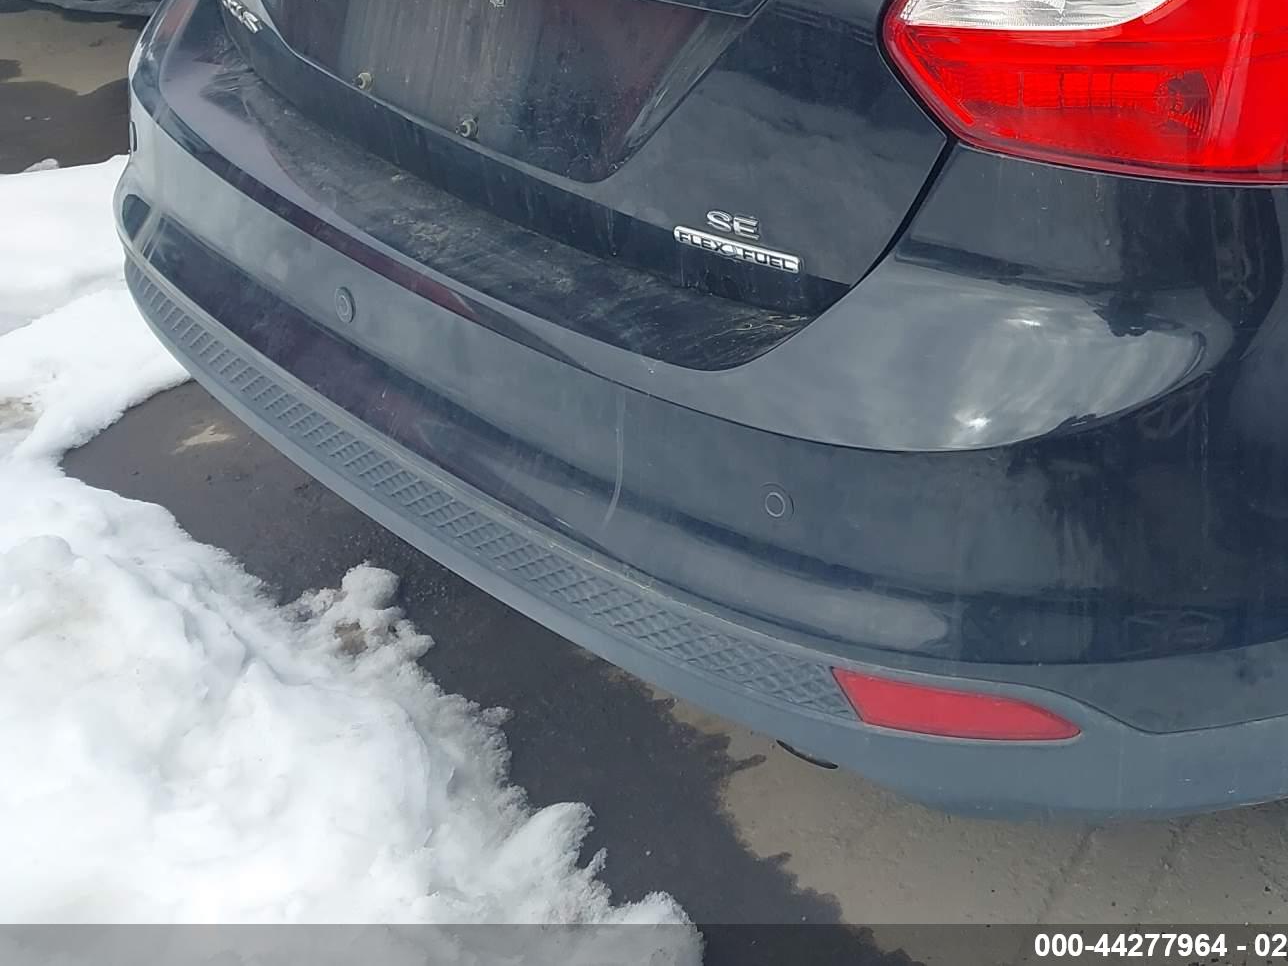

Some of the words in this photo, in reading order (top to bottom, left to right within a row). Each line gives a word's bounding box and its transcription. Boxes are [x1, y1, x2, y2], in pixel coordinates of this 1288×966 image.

[706, 210, 760, 241] SE
[678, 233, 729, 255] FLEX
[741, 248, 796, 272] FUEL
